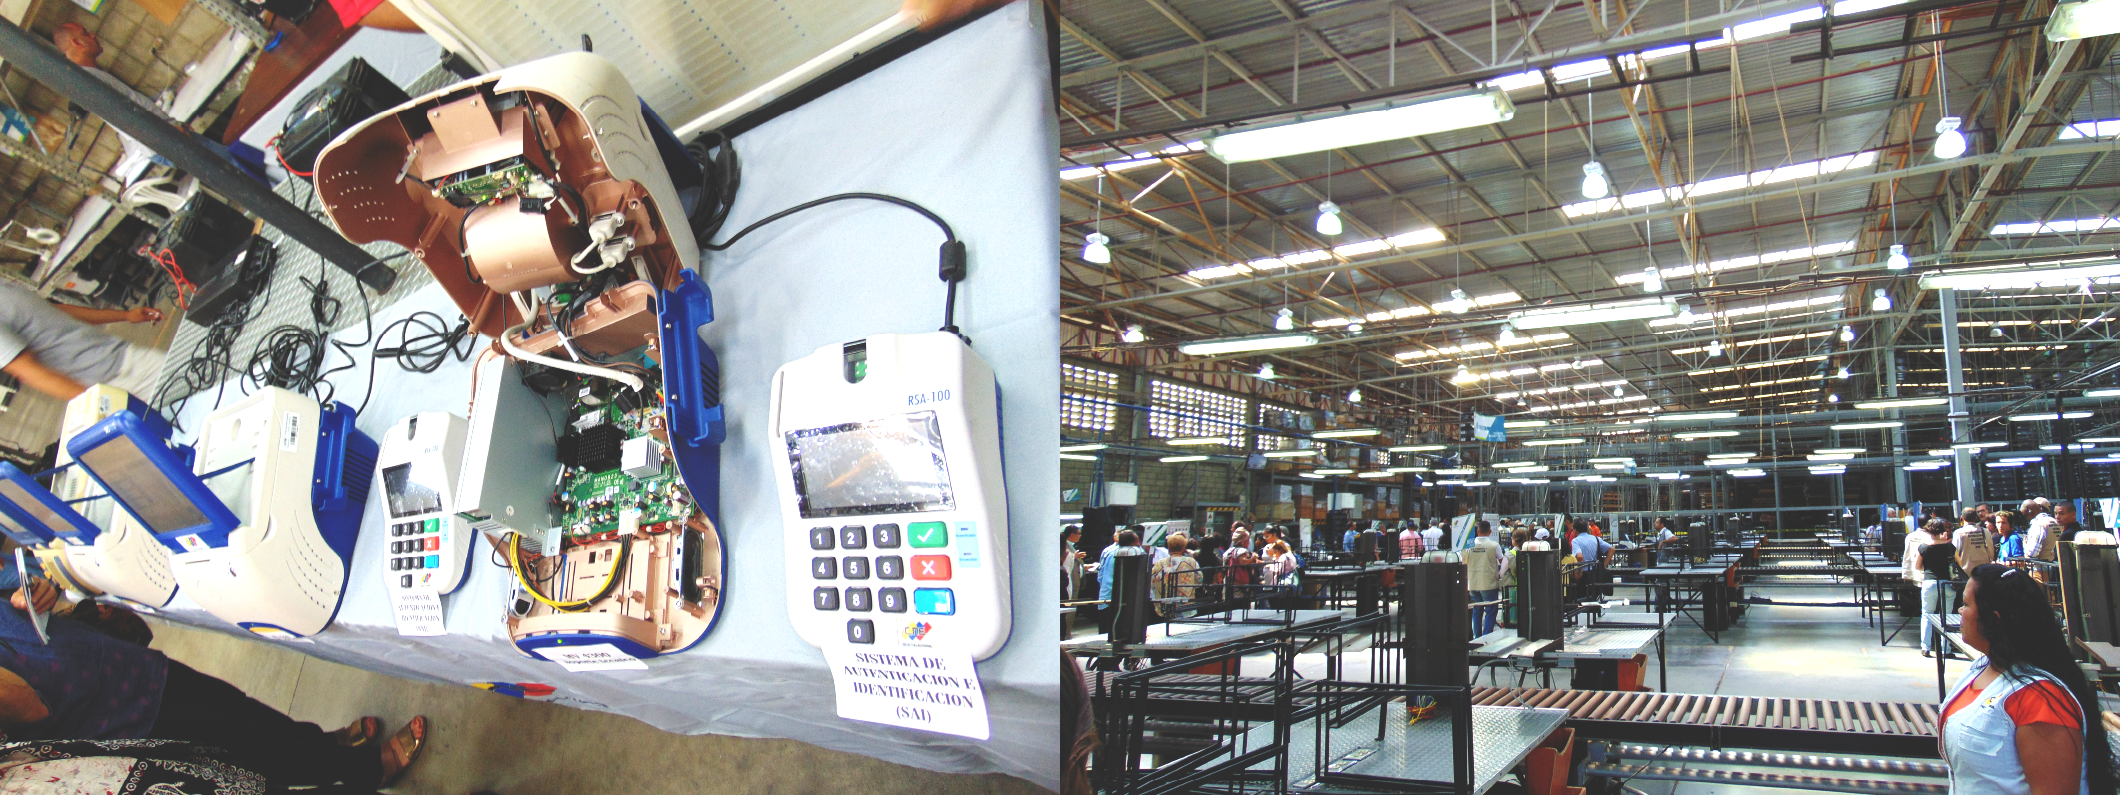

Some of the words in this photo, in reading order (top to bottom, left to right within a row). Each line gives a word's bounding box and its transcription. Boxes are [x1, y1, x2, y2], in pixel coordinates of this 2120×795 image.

[908, 389, 951, 406] RSA-100
[815, 533, 823, 545] 1
[846, 532, 855, 545] 2
[880, 530, 889, 543] 3
[818, 562, 826, 575] 4
[850, 561, 858, 574] 5
[882, 561, 891, 575] 6
[820, 592, 828, 605] 7
[852, 593, 860, 606] 8
[885, 594, 894, 607] 9
[853, 625, 862, 638] 0
[855, 652, 920, 669] SISTEMA
[922, 657, 946, 671] DE
[844, 665, 960, 689] AUTENTICACION
[963, 678, 977, 691] E
[853, 681, 974, 709] IDENTIFICACION
[896, 705, 932, 724] (SAI)
